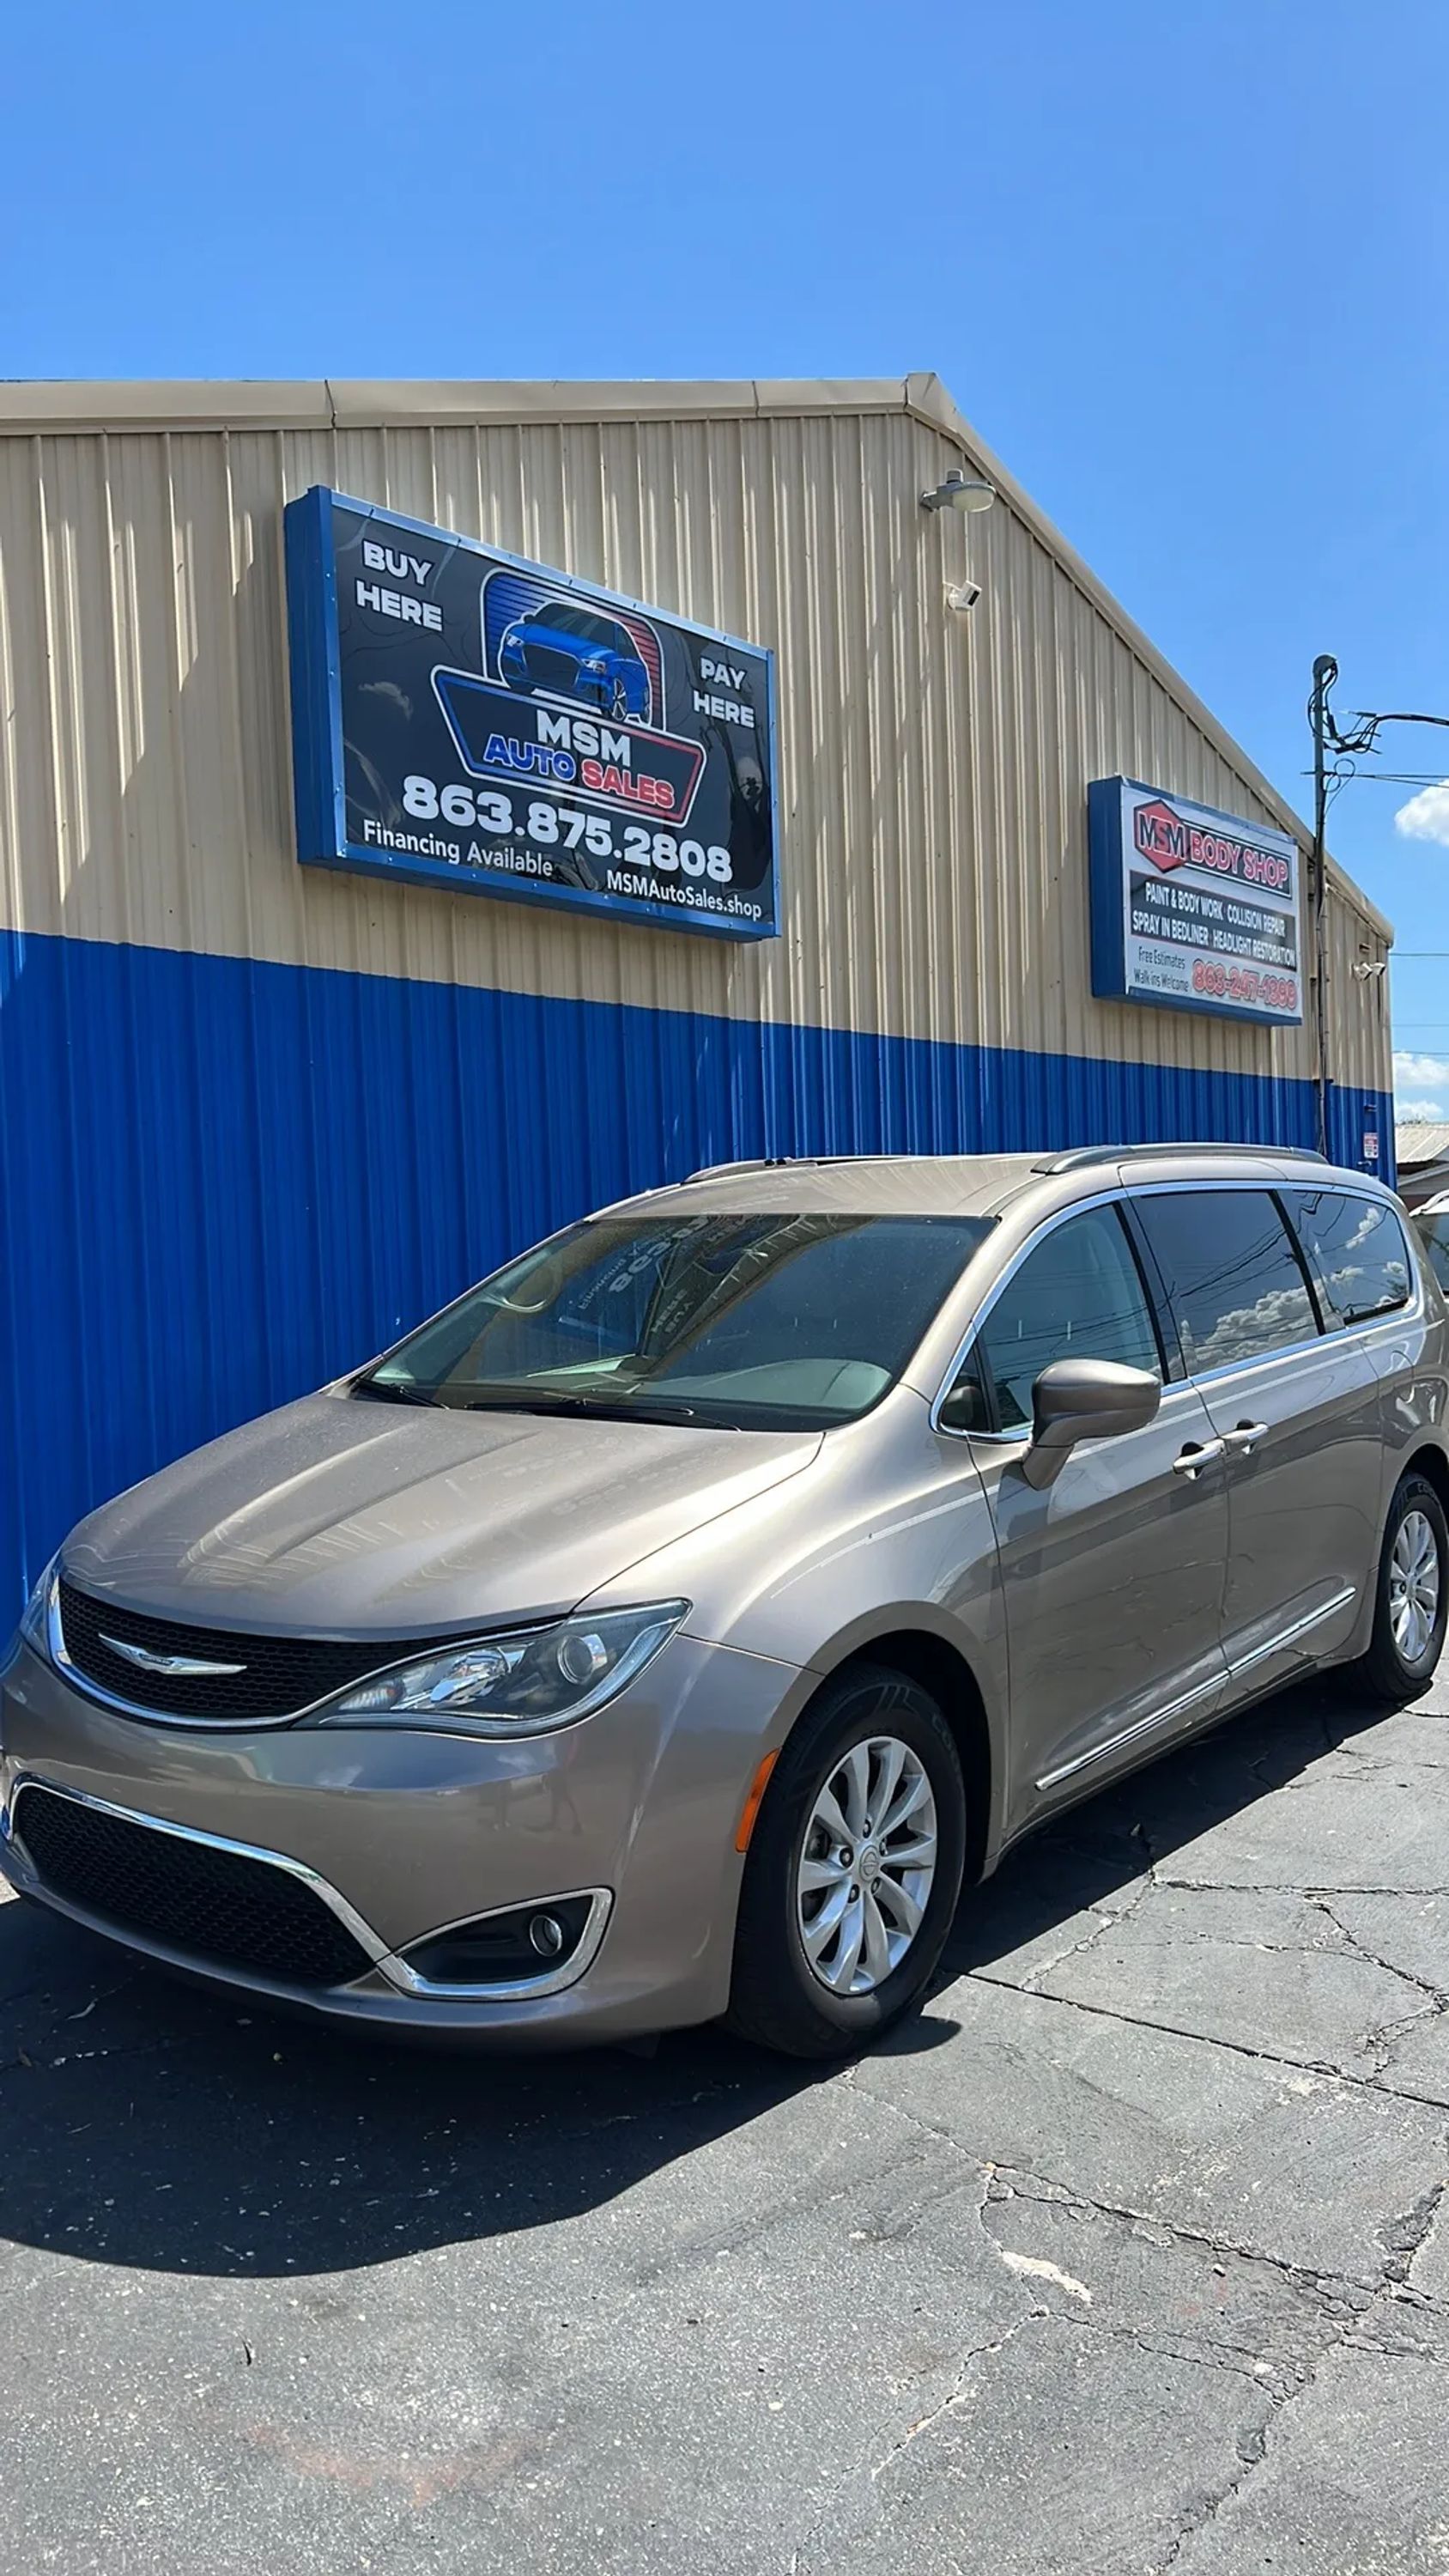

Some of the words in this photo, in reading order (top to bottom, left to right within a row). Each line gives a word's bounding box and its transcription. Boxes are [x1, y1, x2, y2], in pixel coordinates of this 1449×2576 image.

[362, 539, 433, 586] BUY
[355, 579, 443, 632] HERE
[700, 657, 746, 690] PAY
[693, 690, 755, 729] HERE
[536, 709, 631, 768] MSM
[482, 732, 577, 781] AUTO
[580, 758, 675, 809] SALES
[362, 818, 460, 866] Financing
[466, 841, 553, 877] Available
[402, 775, 733, 884] 863.875.2808
[1138, 811, 1186, 861] MSM
[1190, 829, 1241, 875] BODY
[1243, 848, 1288, 889] SHOP
[606, 869, 762, 922] MSMAutoSales.shop
[1145, 881, 1170, 907] PAINT
[1171, 888, 1178, 909] &
[1178, 890, 1200, 914] BODY
[1200, 896, 1223, 921] WORK
[1227, 903, 1262, 932] COLLISION
[1263, 913, 1286, 938] REPAIR
[1132, 909, 1160, 936] SPRAY
[1161, 915, 1171, 939] IN
[1171, 918, 1210, 946] BEDLINER
[1212, 928, 1252, 957] HEADLIGHT
[1252, 939, 1296, 968] RESTORATION
[1138, 945, 1153, 963] Free
